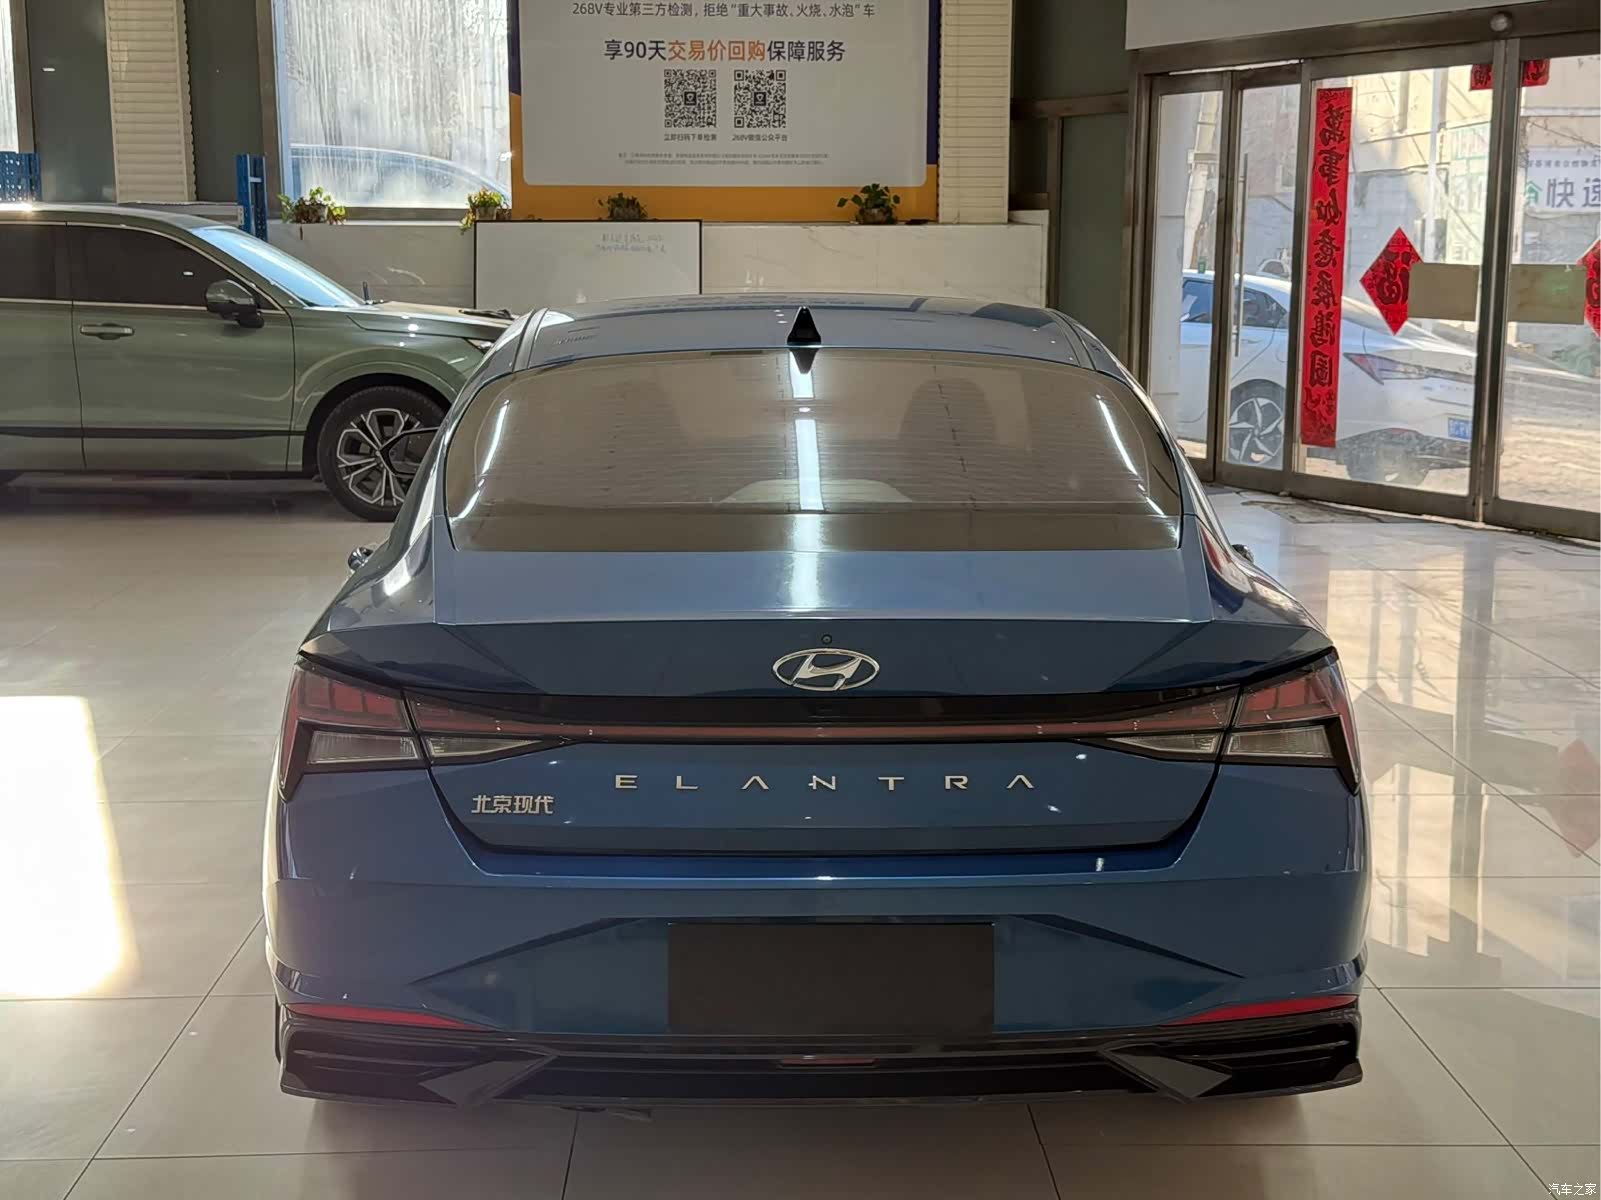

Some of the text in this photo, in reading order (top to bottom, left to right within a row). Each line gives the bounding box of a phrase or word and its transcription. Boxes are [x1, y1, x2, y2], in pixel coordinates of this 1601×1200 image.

[604, 39, 846, 62] 享90天交易价回购保障服务
[614, 774, 1036, 791] ELANTRA
[471, 794, 555, 814] 北京现代
